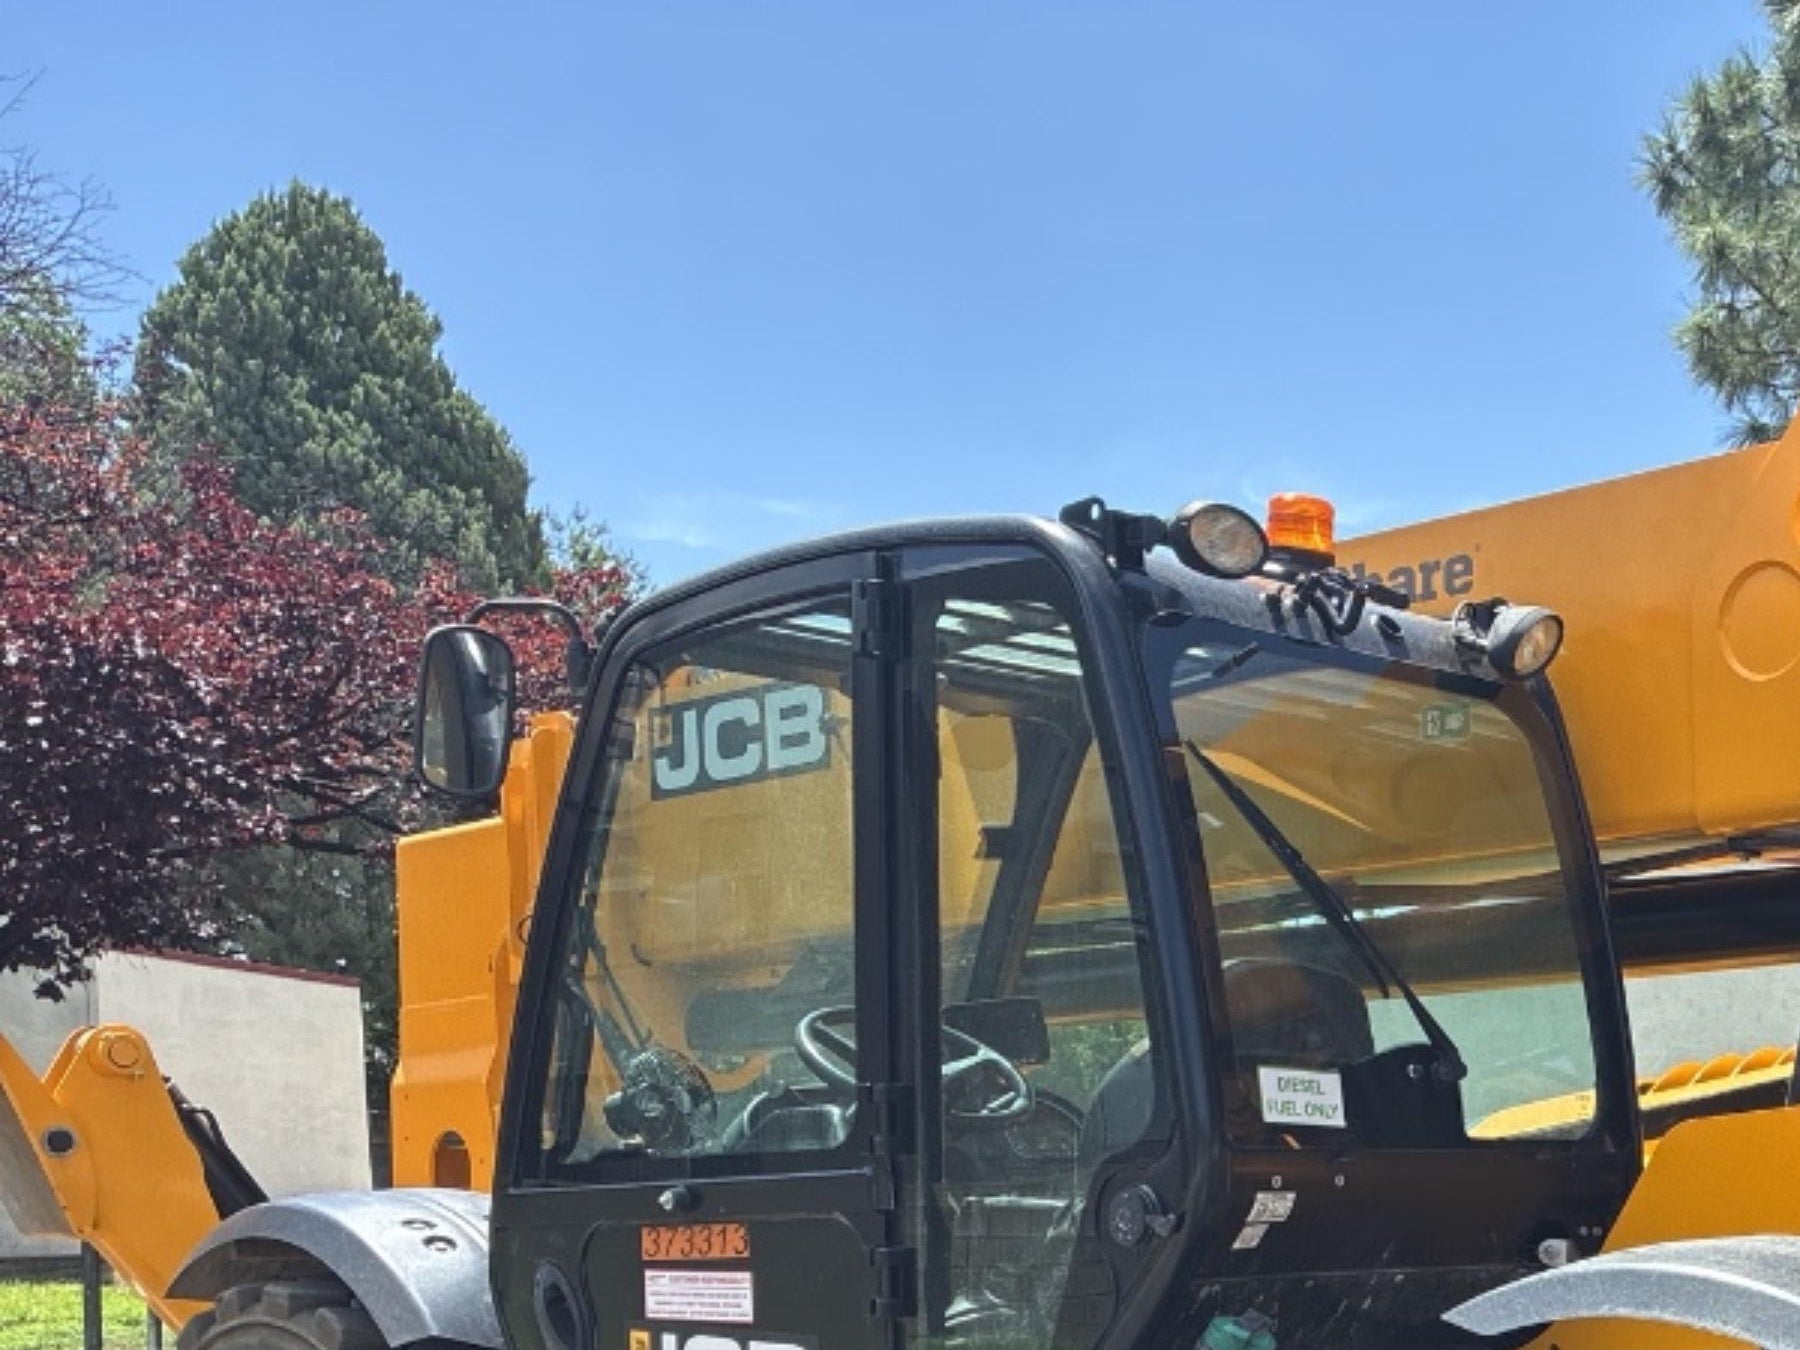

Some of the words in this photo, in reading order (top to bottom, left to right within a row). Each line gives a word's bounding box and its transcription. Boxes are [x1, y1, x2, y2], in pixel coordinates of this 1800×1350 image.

[654, 683, 827, 790] JCB
[1277, 1076, 1326, 1096] DIESEL
[643, 1224, 748, 1258] 373313
